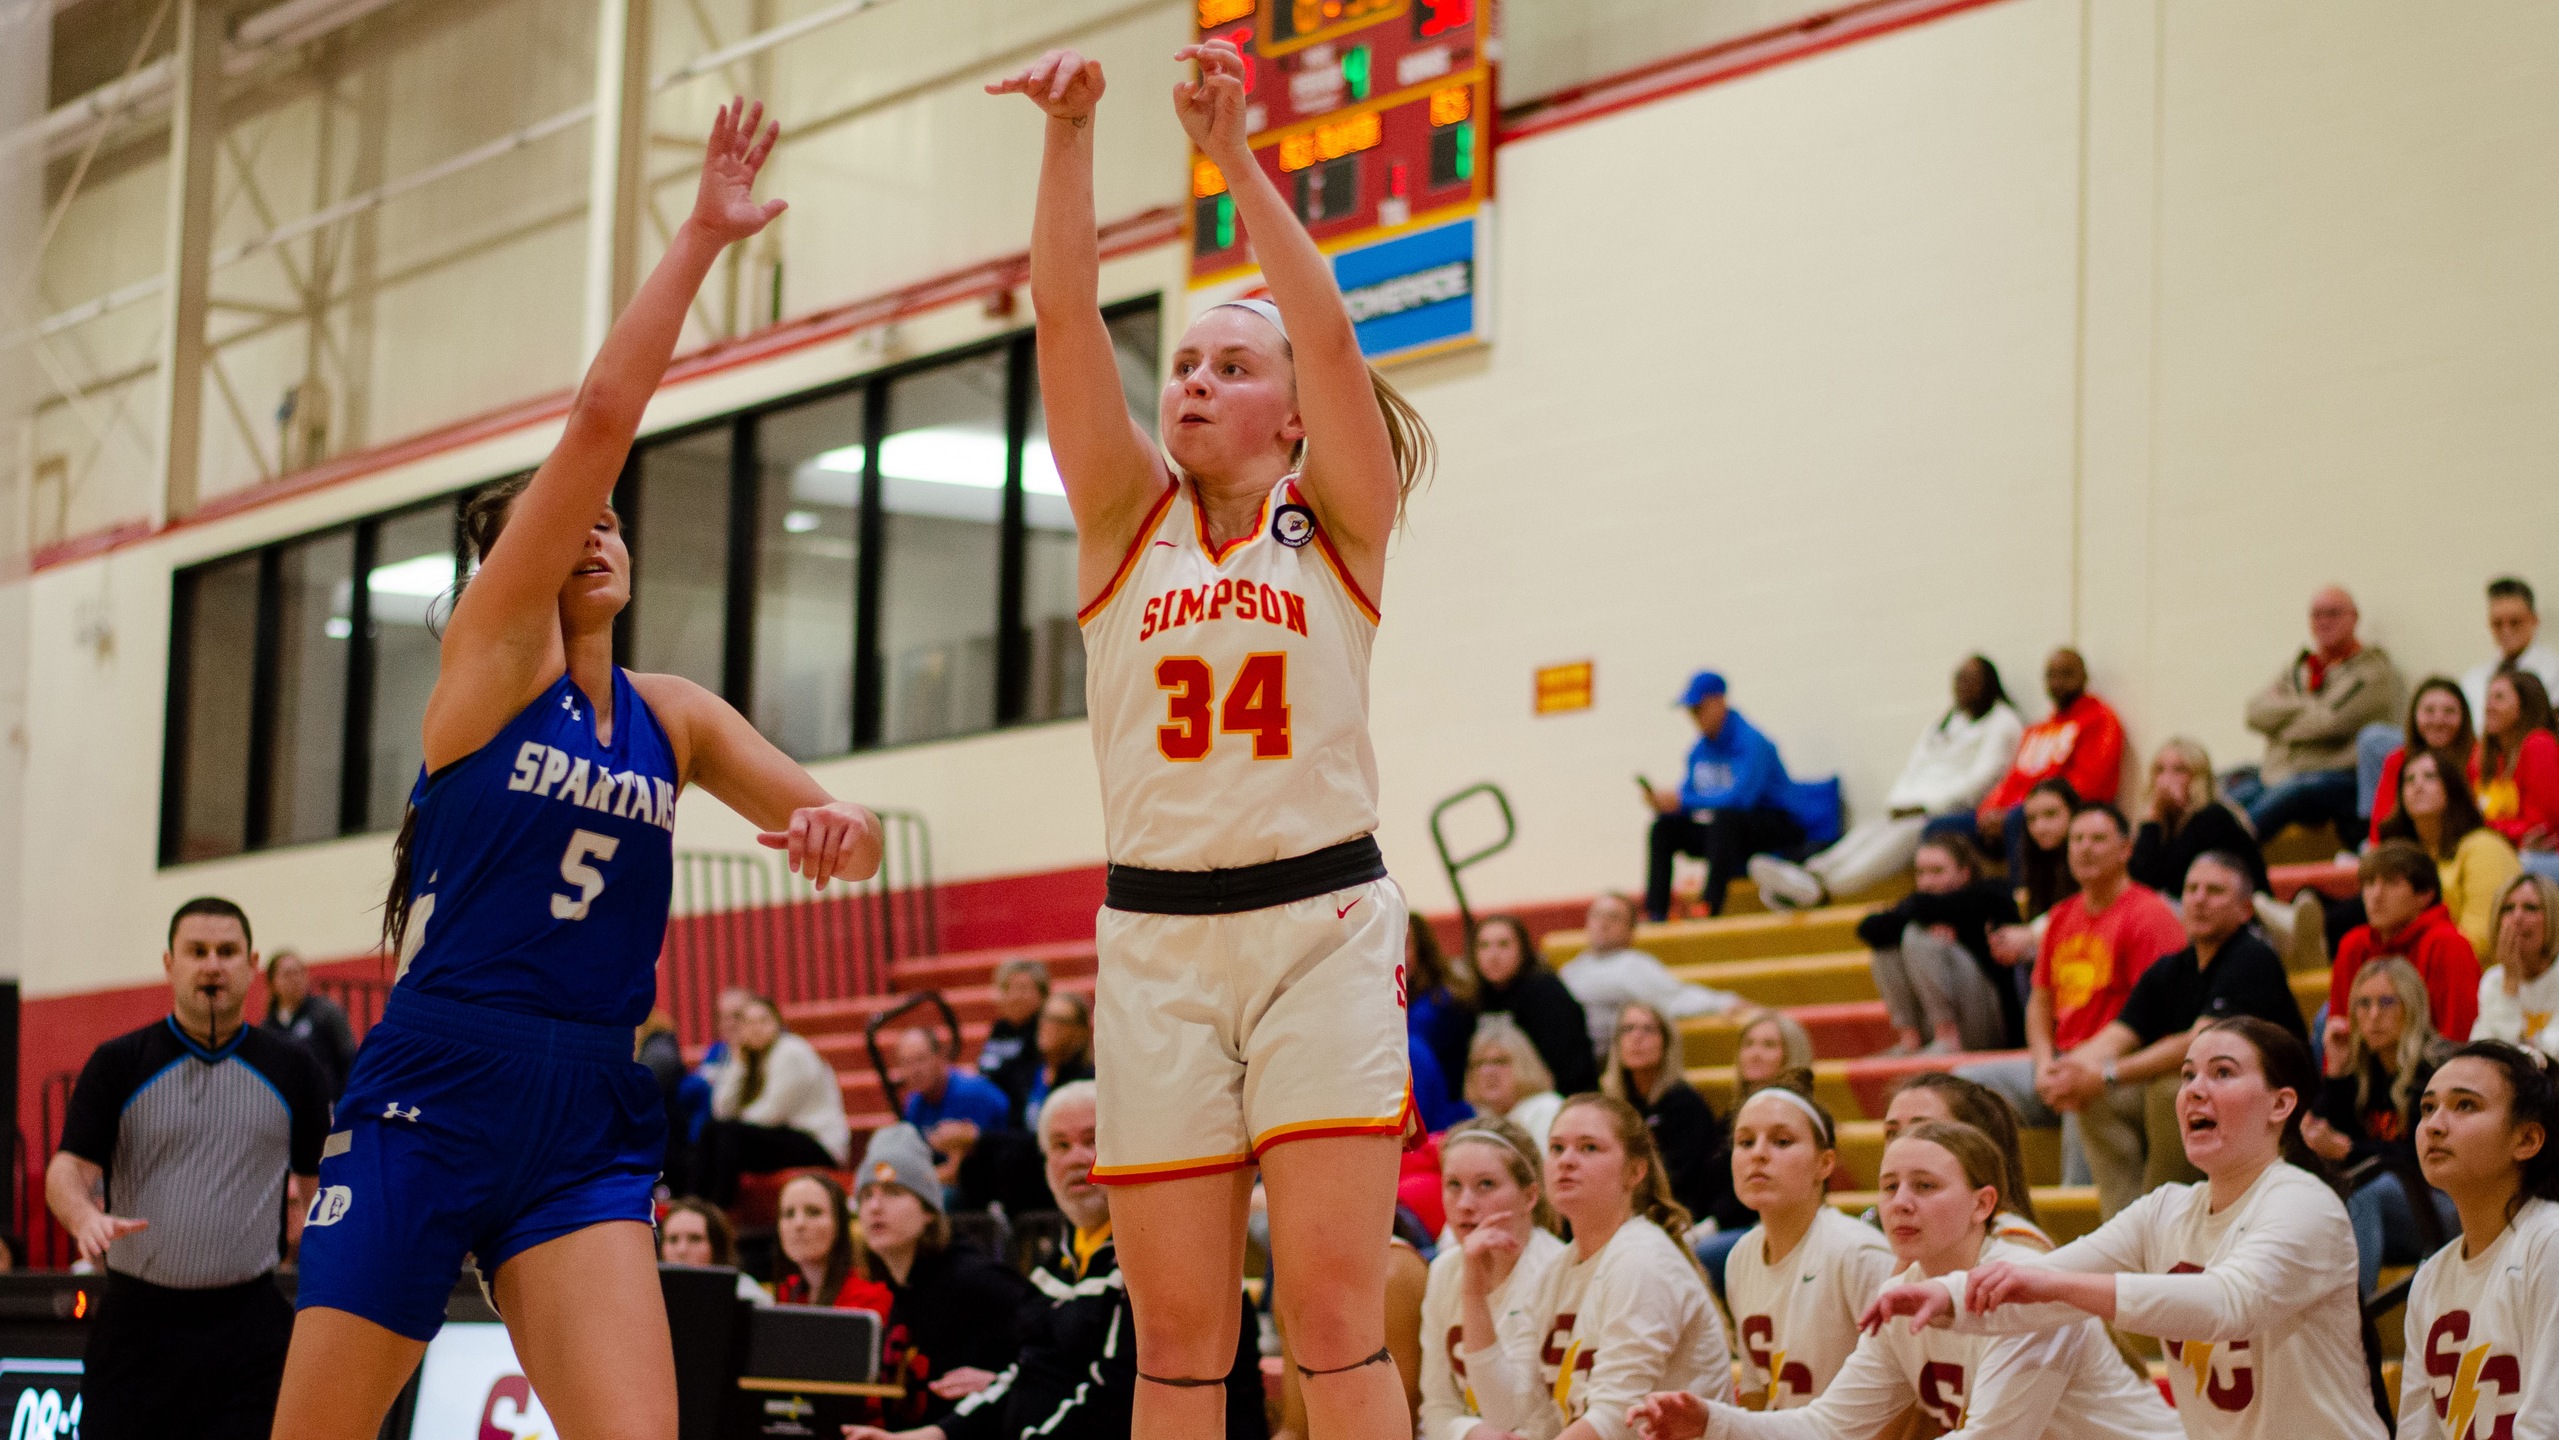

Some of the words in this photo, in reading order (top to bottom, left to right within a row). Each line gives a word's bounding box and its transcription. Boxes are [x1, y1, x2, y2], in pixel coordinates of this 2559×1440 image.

[1140, 578, 1308, 642] SIMPSON
[1154, 651, 1292, 762] 34
[508, 740, 675, 833] SPARTANS
[551, 828, 620, 921] 5
